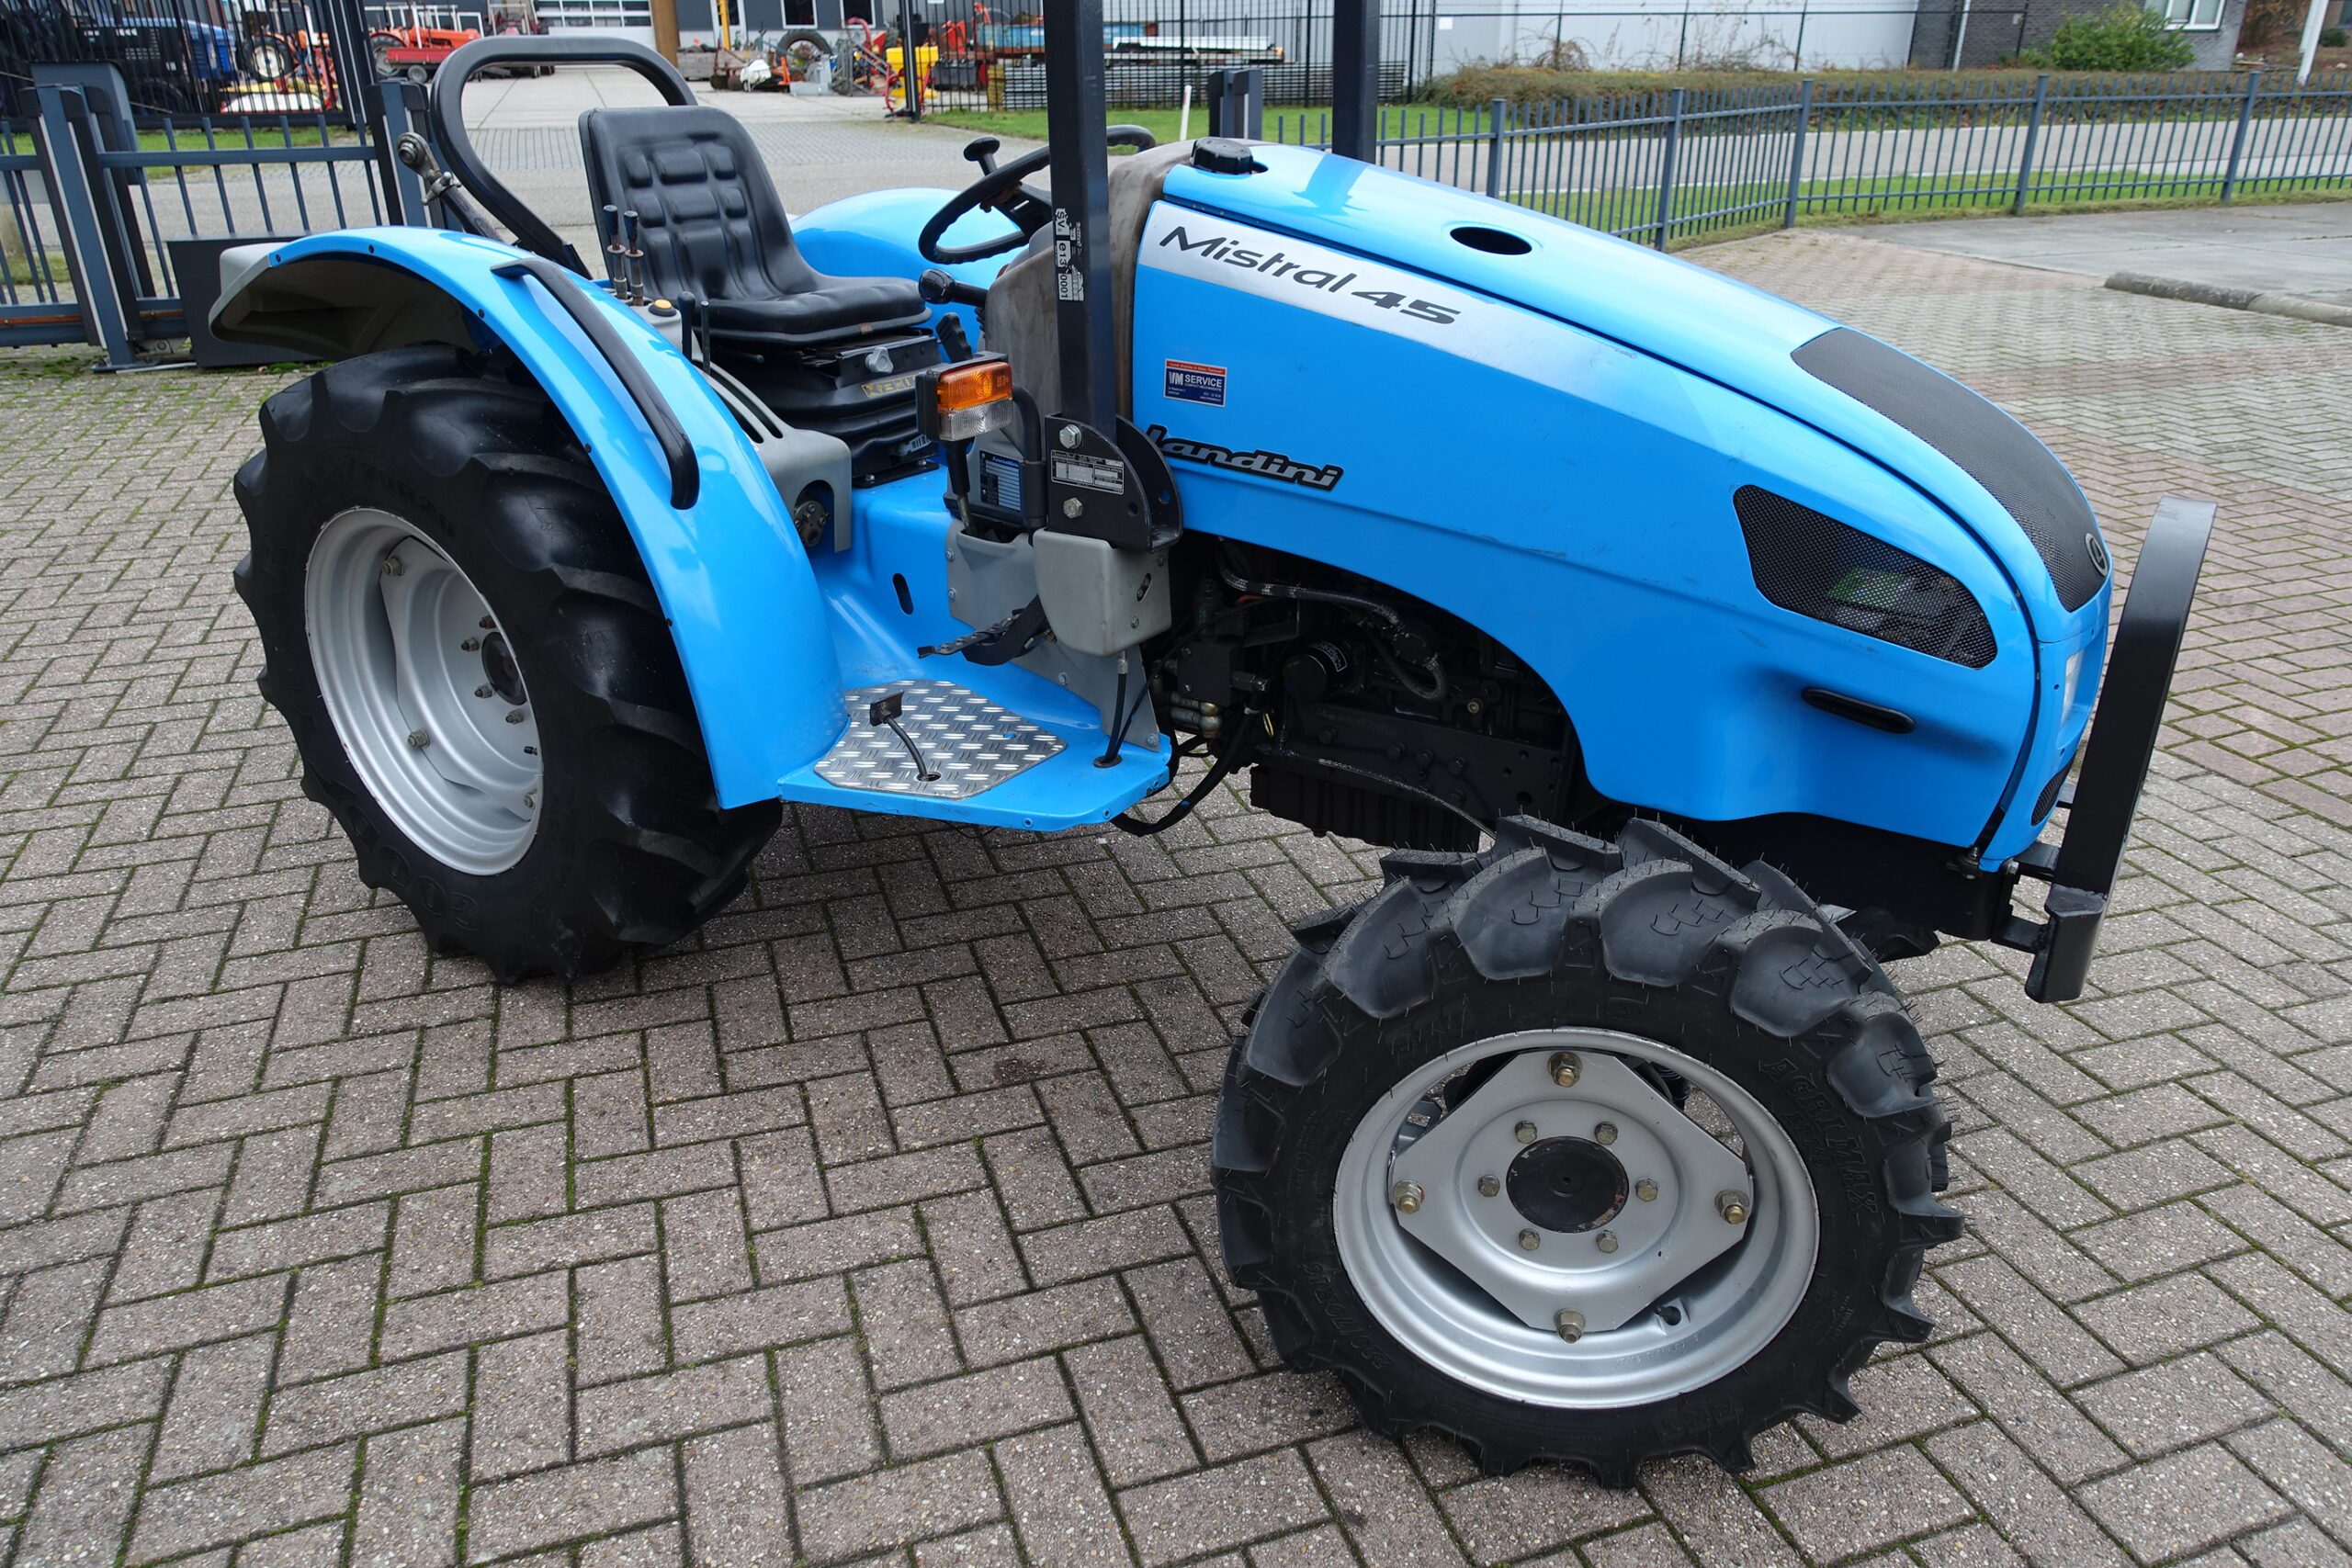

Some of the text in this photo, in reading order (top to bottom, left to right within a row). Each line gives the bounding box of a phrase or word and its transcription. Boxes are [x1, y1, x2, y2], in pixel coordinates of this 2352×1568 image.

[1059, 275, 1069, 299] 0001
[1159, 226, 1462, 325] Mistral 45
[1185, 374, 1223, 388] SERVICE
